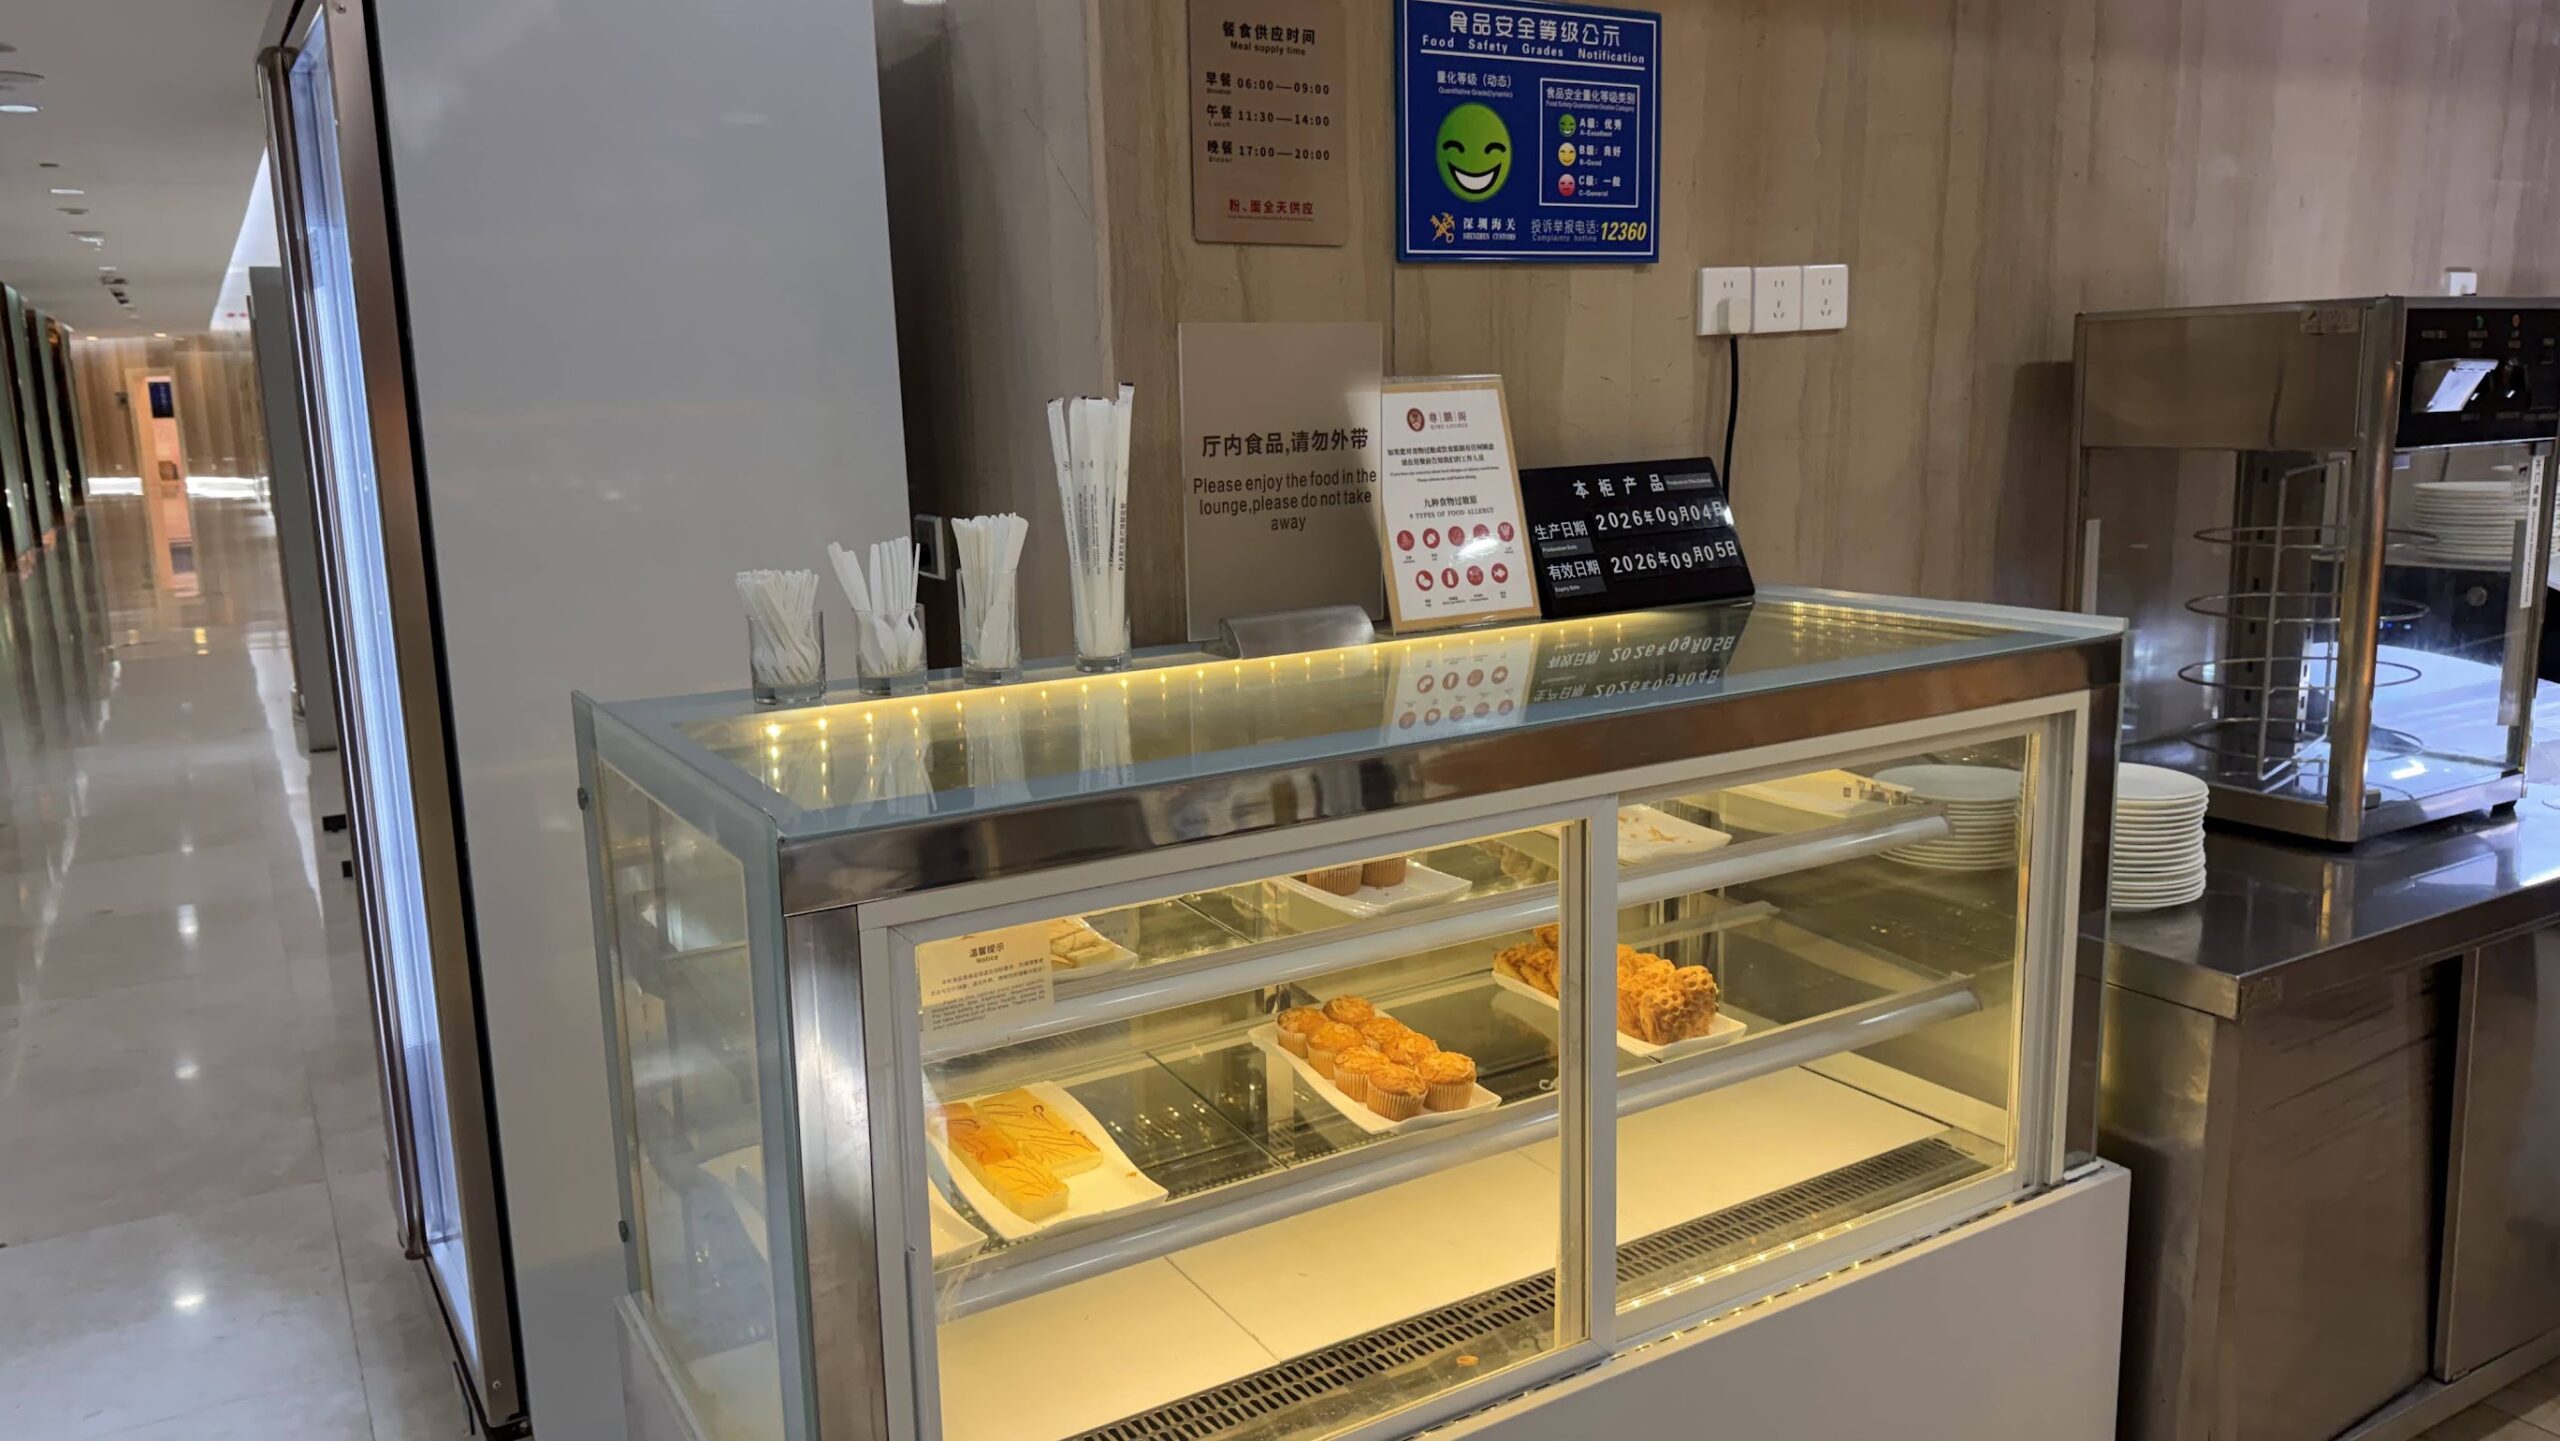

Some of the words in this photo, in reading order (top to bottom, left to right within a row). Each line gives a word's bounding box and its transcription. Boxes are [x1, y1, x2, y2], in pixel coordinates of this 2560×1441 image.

[1222, 20, 1315, 45] 餐食供应时间
[1449, 10, 1621, 47] 食品安全等级公示
[1230, 40, 1252, 51] Meal
[1254, 44, 1284, 56] supply
[1287, 45, 1306, 56] time
[1422, 34, 1455, 49] Food
[1468, 38, 1508, 55] Safety
[1521, 43, 1564, 58] Grades
[1577, 49, 1645, 64] Notification
[1206, 71, 1231, 87] 早餐
[1546, 86, 1636, 104] 食品安全量化等级类别
[1206, 104, 1231, 119] 午餐
[1207, 140, 1232, 155] 晚餐
[1228, 198, 1314, 215] 粉、面全天供应
[1462, 217, 1516, 231] 深圳海关
[1600, 221, 1648, 241] 12360
[1193, 477, 1242, 494] Please
[1245, 474, 1283, 493] enjoy
[1286, 472, 1307, 488] the
[1310, 469, 1340, 486] food
[1342, 468, 1354, 484] in
[1356, 468, 1377, 483] the
[1301, 492, 1318, 508] do
[1320, 490, 1341, 506] not
[1343, 489, 1372, 505] take
[1448, 509, 1465, 517] FOOD
[1467, 507, 1494, 516] ALLERGY
[1534, 519, 1589, 541] 生产日期
[1595, 500, 1724, 531] 2026年09月04日
[1271, 516, 1307, 532] away
[1547, 559, 1602, 580] 有效日期
[1610, 540, 1738, 574] 2026年09月05日
[976, 955, 999, 964] Notice
